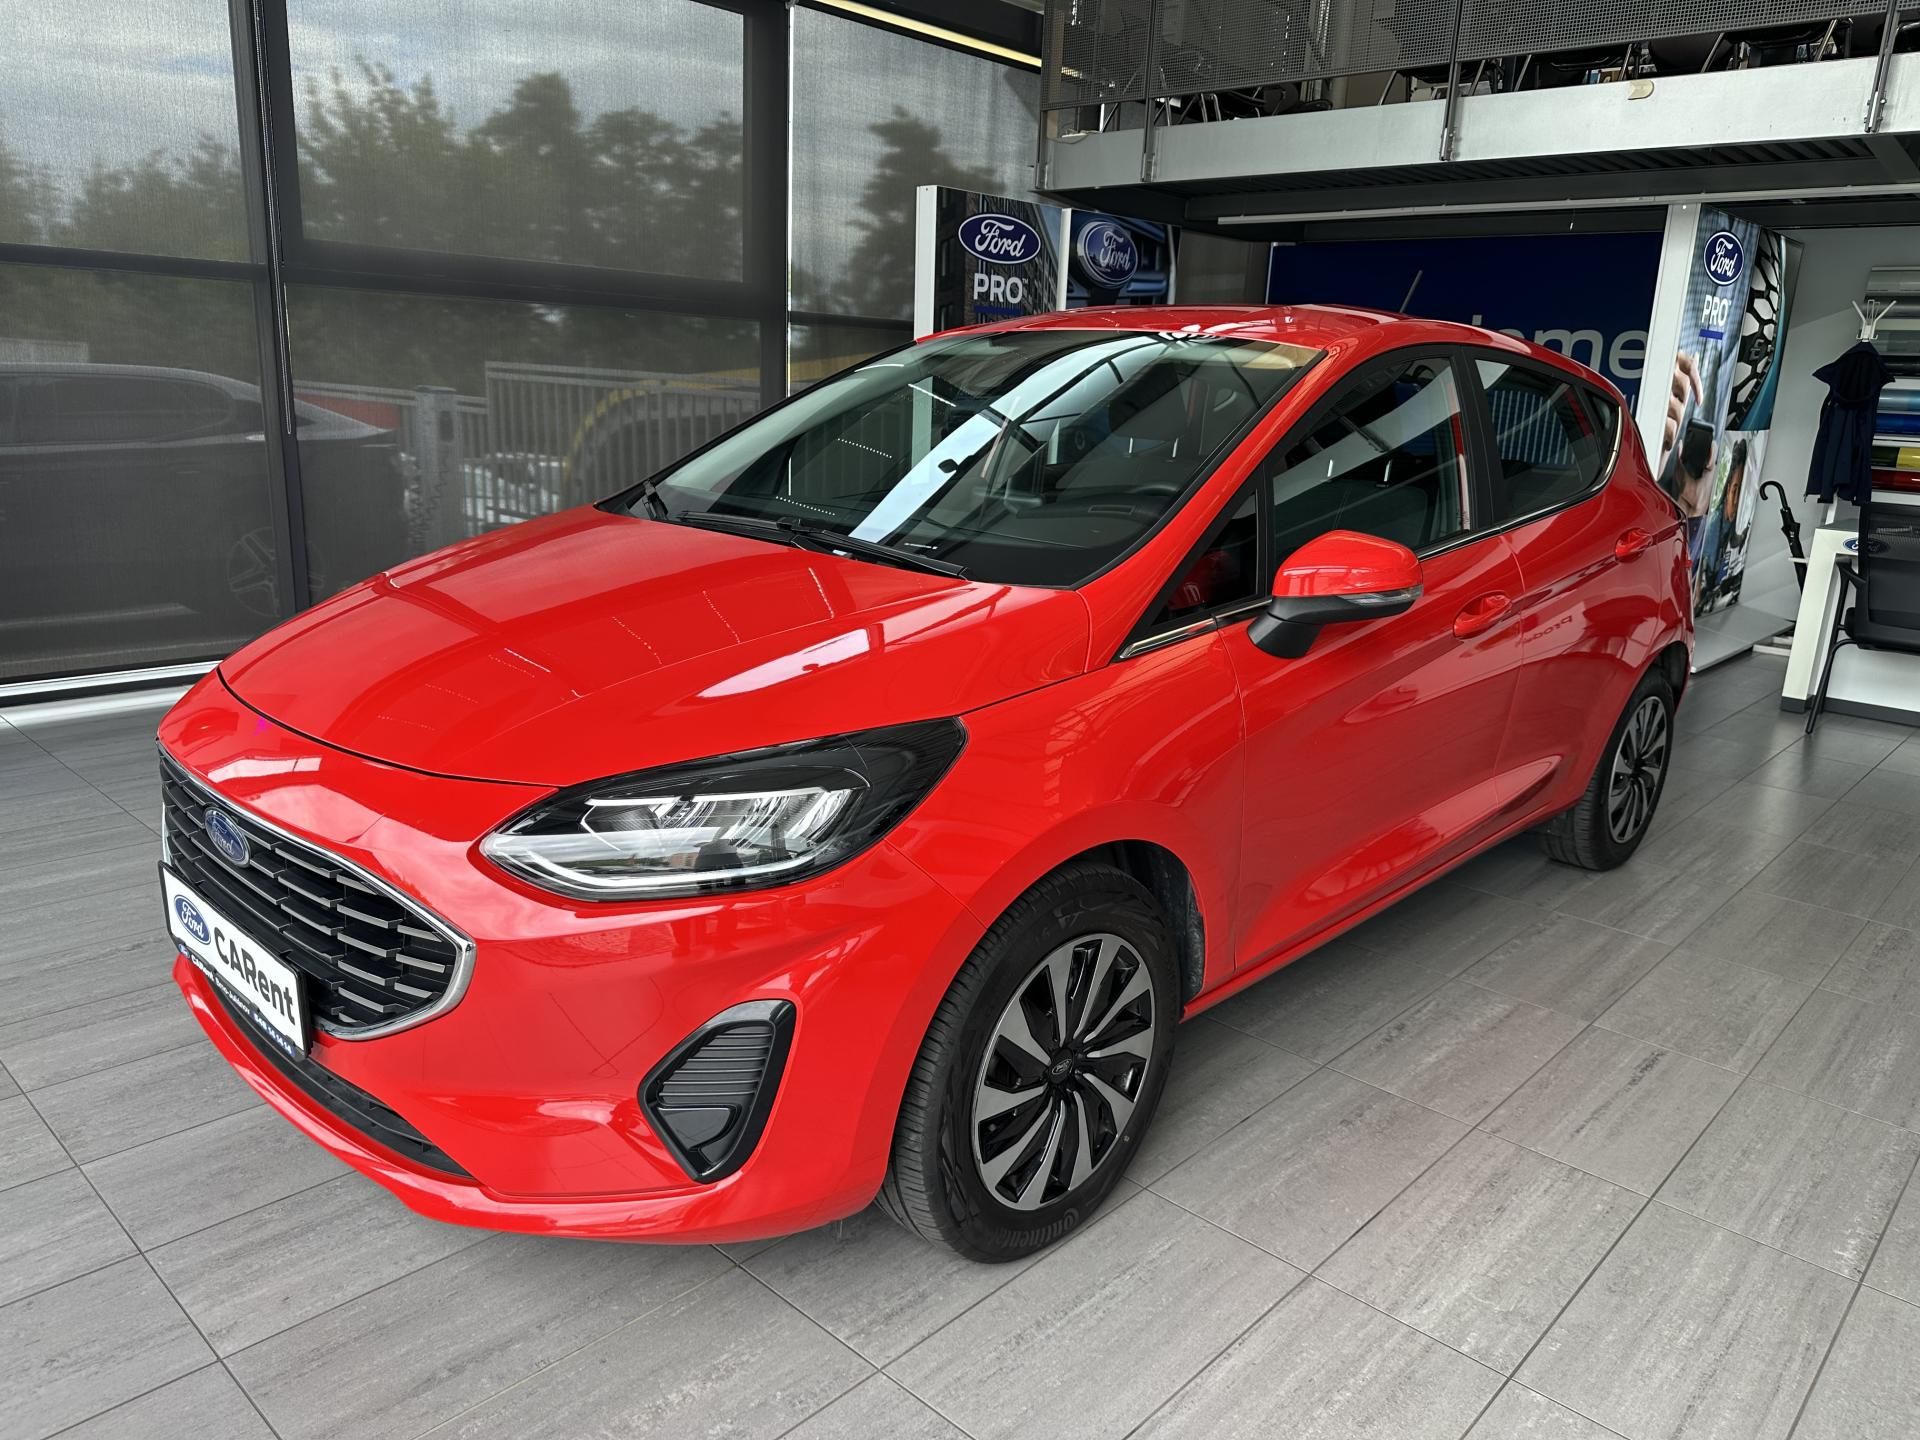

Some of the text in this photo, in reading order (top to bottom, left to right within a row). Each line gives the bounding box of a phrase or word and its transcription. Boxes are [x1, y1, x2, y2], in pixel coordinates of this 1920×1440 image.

[974, 219, 1027, 257] Ford
[1100, 231, 1131, 271] Ford
[1710, 238, 1738, 277] Ford
[181, 901, 205, 940] Ford
[214, 927, 296, 1026] CARent
